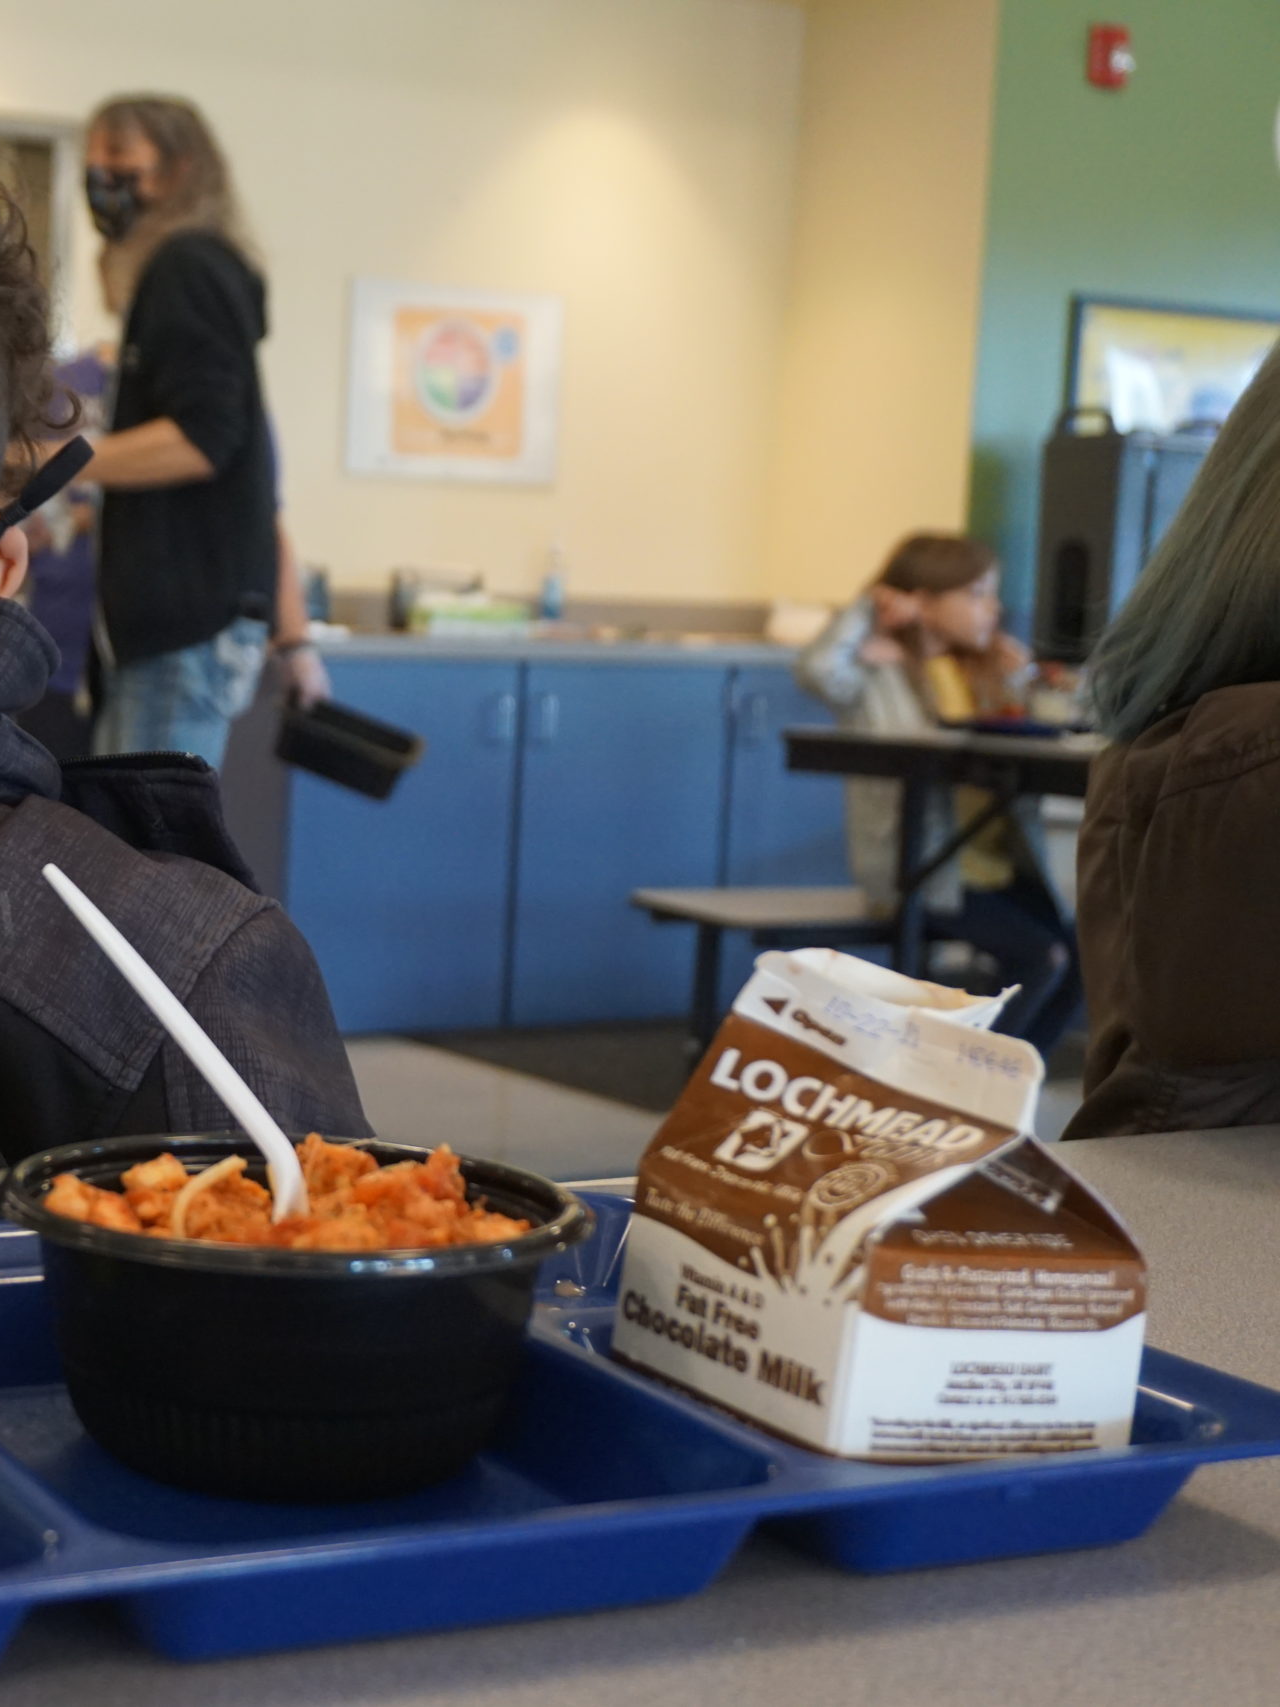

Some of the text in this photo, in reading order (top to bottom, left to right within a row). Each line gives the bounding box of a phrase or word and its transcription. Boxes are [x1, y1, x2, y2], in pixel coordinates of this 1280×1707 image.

[710, 1047, 986, 1151] LOCHMEAD
[623, 1291, 825, 1406] Chocolate Milk
[675, 1284, 760, 1340] Fat Free
